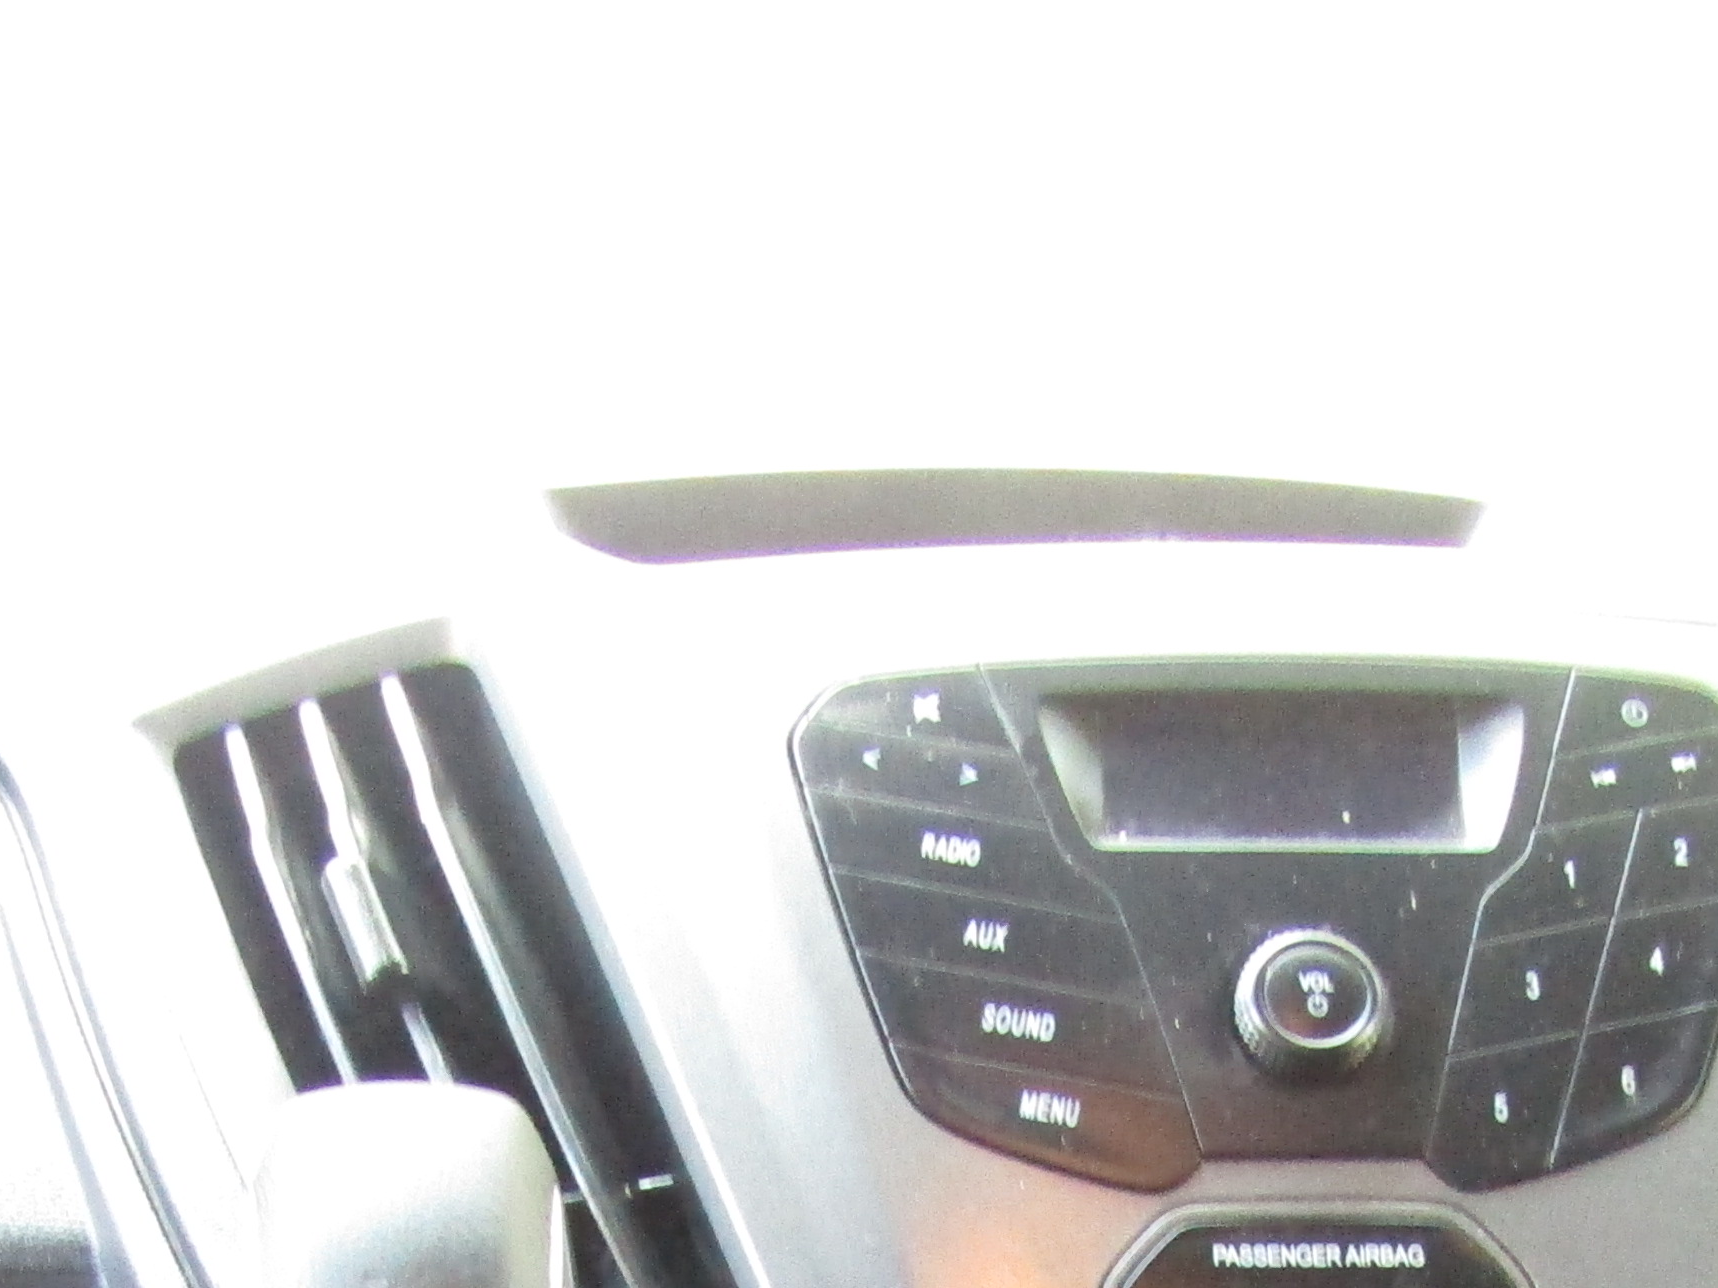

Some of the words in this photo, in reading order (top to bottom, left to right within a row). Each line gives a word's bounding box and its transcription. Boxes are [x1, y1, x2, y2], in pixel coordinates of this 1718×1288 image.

[920, 831, 982, 868] RADIO
[1672, 836, 1688, 867] 2
[1563, 859, 1576, 889] 1
[962, 918, 1010, 954] AUX
[1649, 945, 1664, 976] 4
[1298, 969, 1335, 994] VOL
[1525, 968, 1541, 1001] 3
[981, 1002, 1057, 1043] SOUND
[1621, 1064, 1636, 1096] 6
[1019, 1088, 1082, 1129] MENU
[1494, 1091, 1509, 1124] 5
[1211, 1241, 1342, 1269] PASSENGER
[1345, 1242, 1426, 1270] AIRBAG
